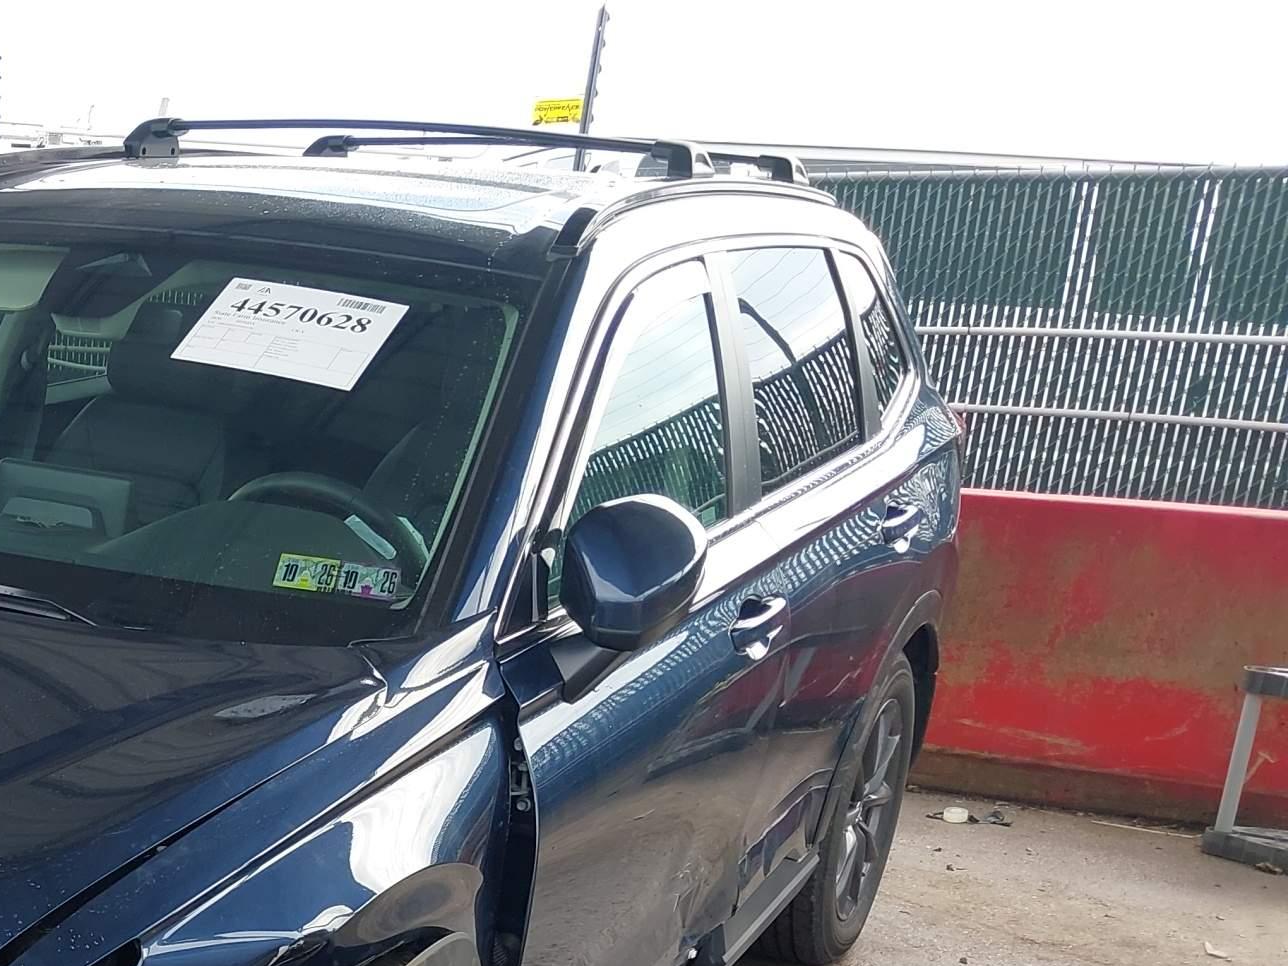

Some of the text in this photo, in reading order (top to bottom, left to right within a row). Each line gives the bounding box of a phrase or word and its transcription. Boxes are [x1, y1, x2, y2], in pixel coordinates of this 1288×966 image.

[230, 297, 372, 334] 44570628
[282, 562, 336, 586] 10 26
[342, 569, 398, 594] 10 26
